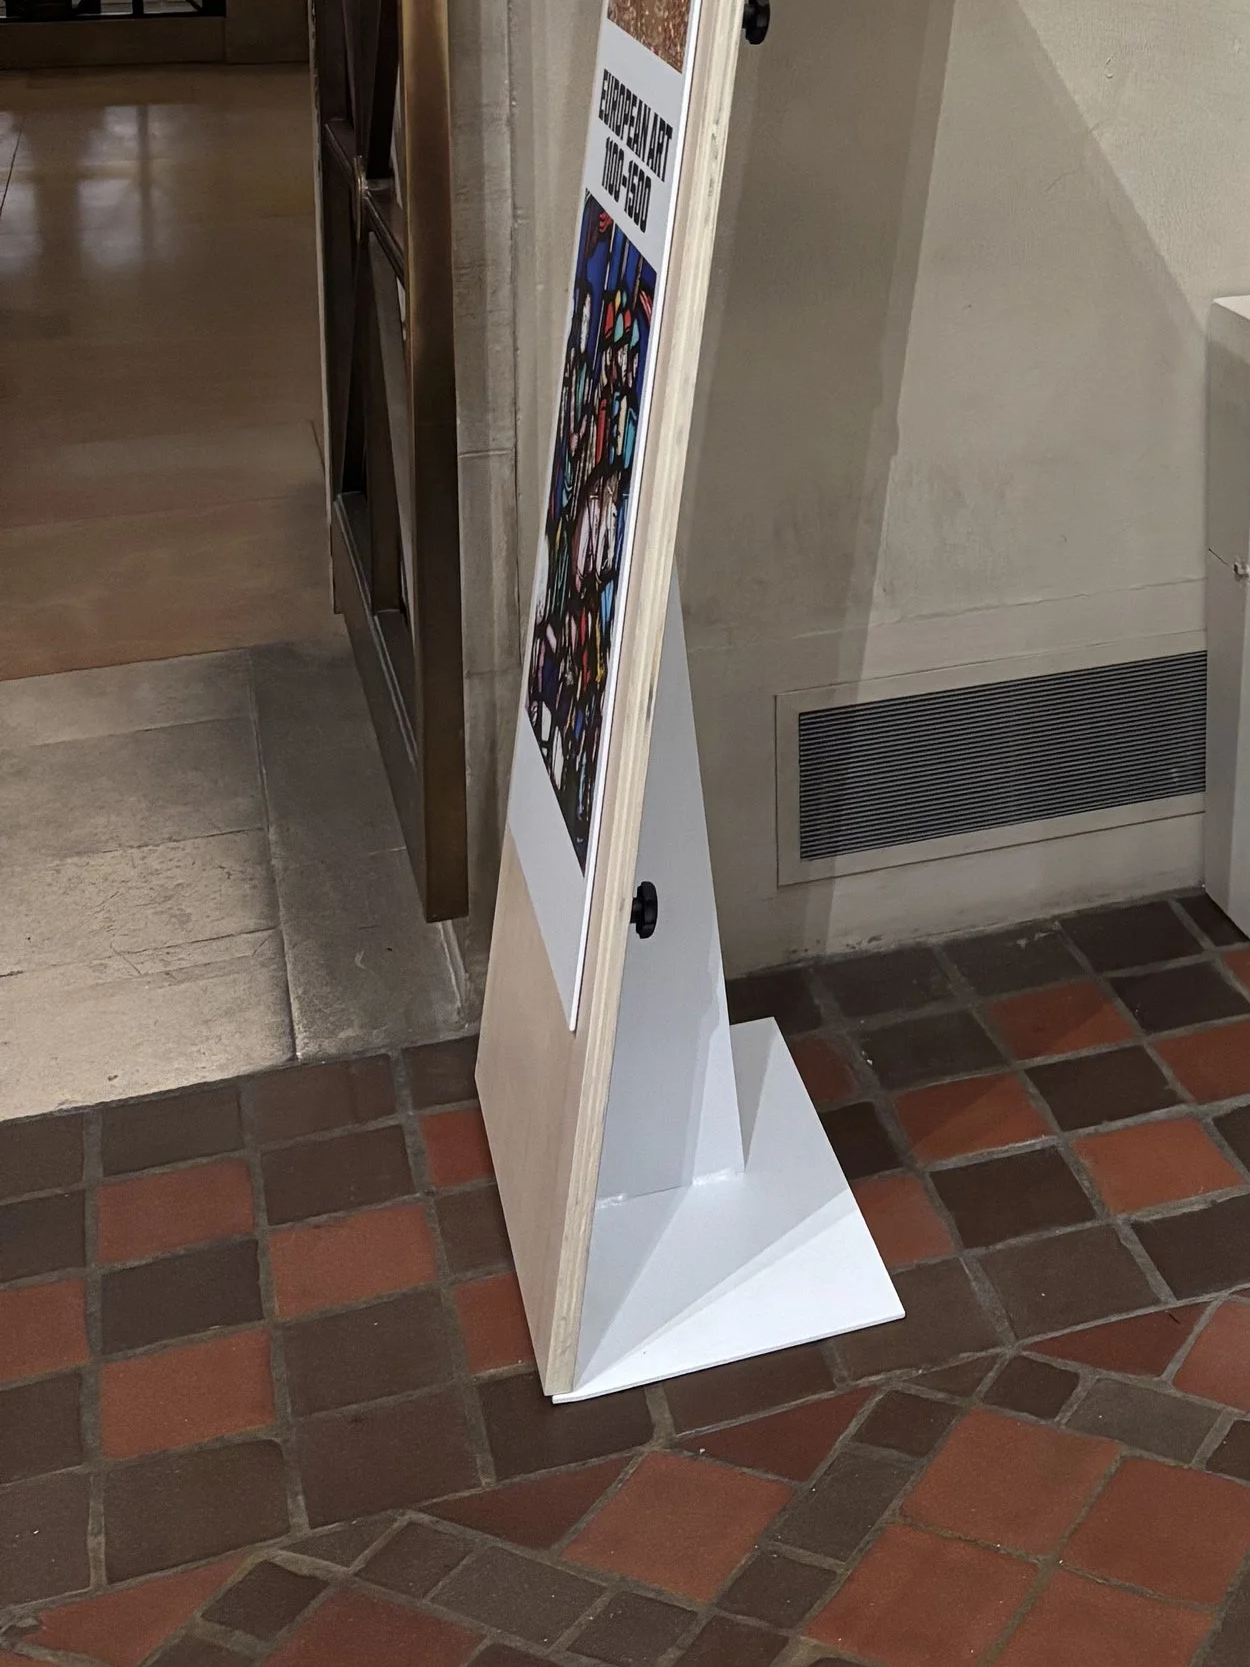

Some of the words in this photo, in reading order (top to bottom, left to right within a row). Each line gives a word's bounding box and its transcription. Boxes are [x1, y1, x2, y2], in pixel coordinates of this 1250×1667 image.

[599, 68, 652, 163] EUROPEAN
[646, 112, 674, 183] ART
[602, 136, 652, 233] 1100-1500
